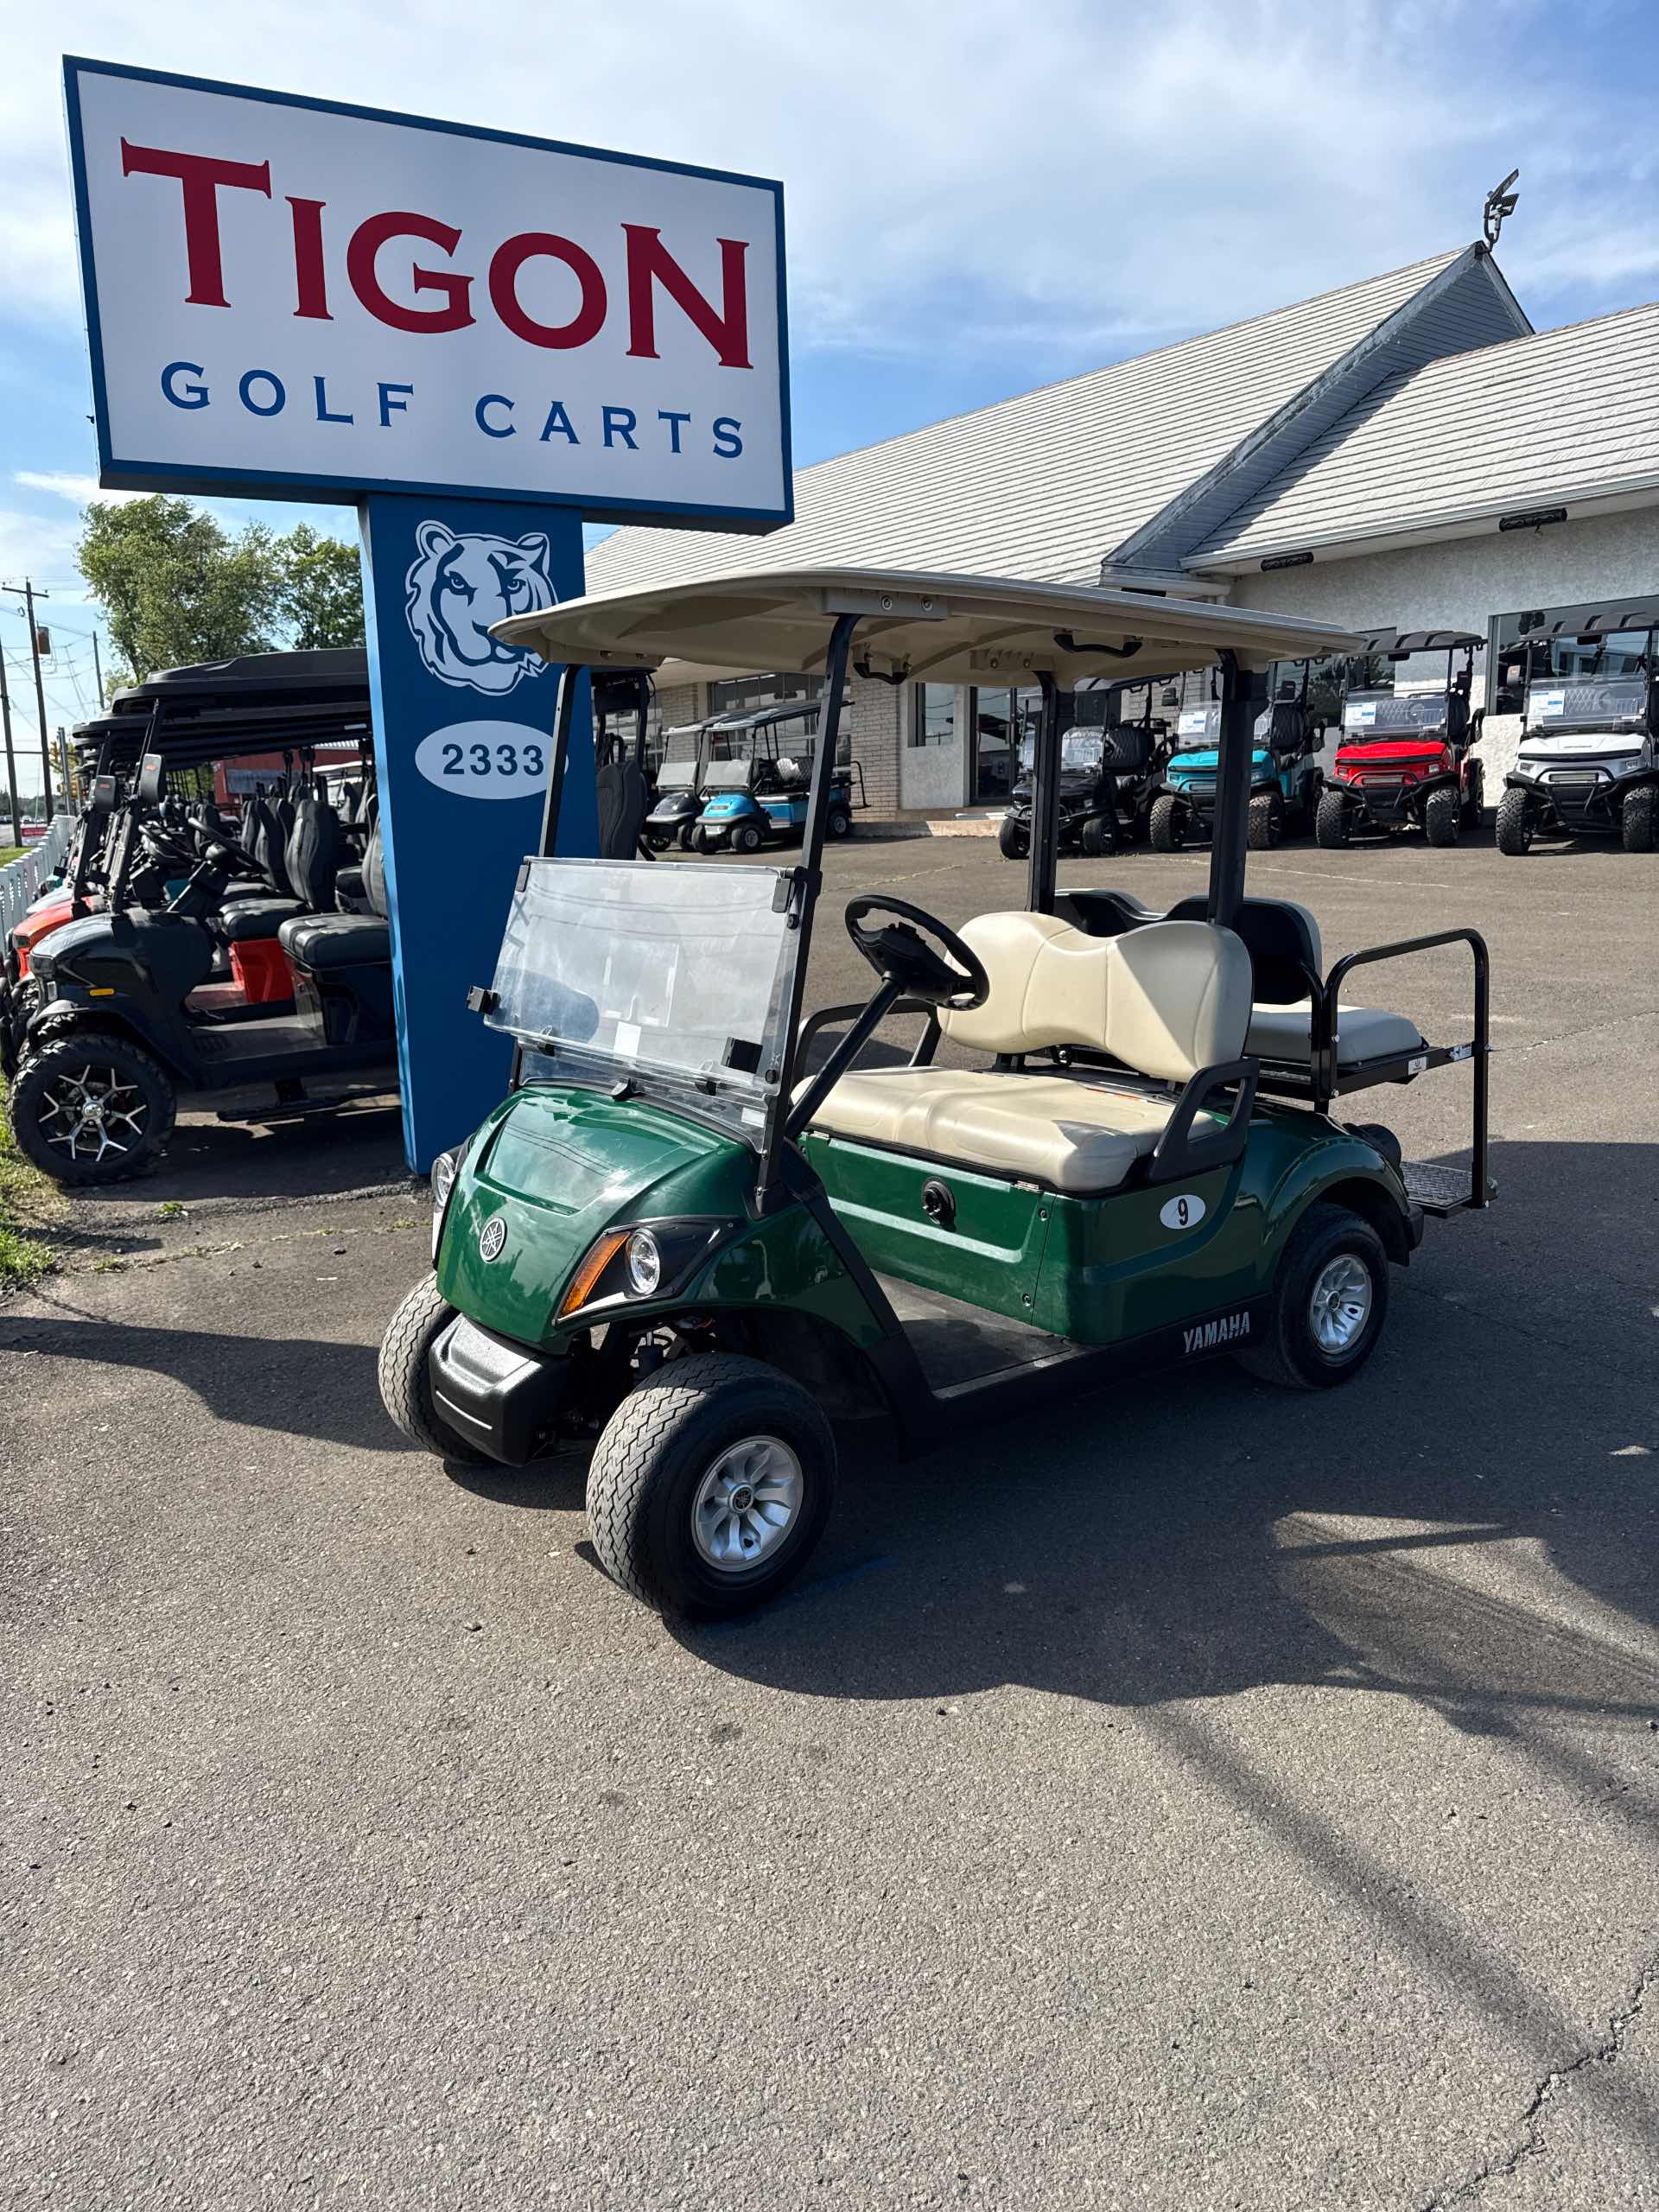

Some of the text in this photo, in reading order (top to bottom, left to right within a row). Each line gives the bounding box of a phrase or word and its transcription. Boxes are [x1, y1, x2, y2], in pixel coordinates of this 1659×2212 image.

[121, 137, 753, 369] TIGON
[161, 361, 744, 459] GOLF CARTS
[442, 743, 544, 776] 2333
[1178, 1198, 1189, 1225] 9
[1184, 1312, 1250, 1353] YAMAHA
